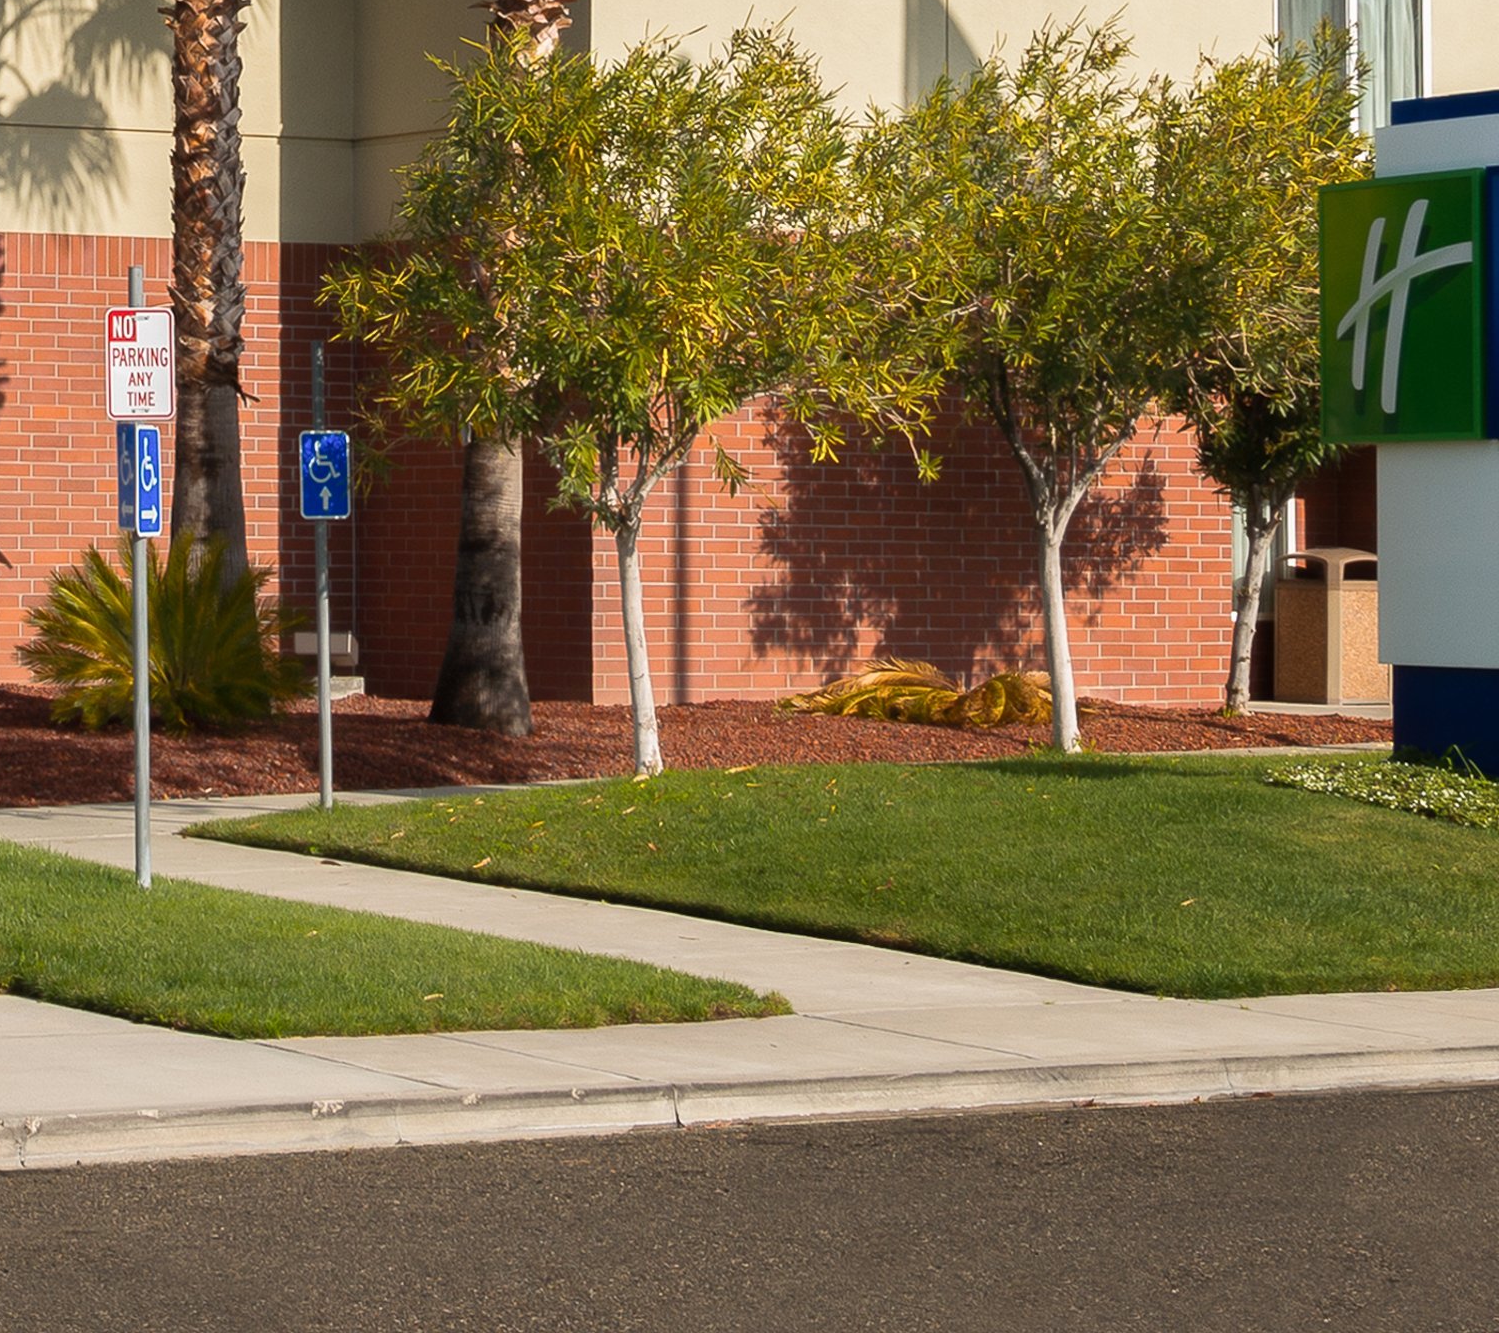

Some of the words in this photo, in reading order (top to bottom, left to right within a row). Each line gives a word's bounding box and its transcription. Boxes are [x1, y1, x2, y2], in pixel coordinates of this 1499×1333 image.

[112, 315, 135, 339] NO
[112, 347, 169, 368] PARKING
[128, 371, 153, 387] ANY
[126, 391, 155, 407] TIME
